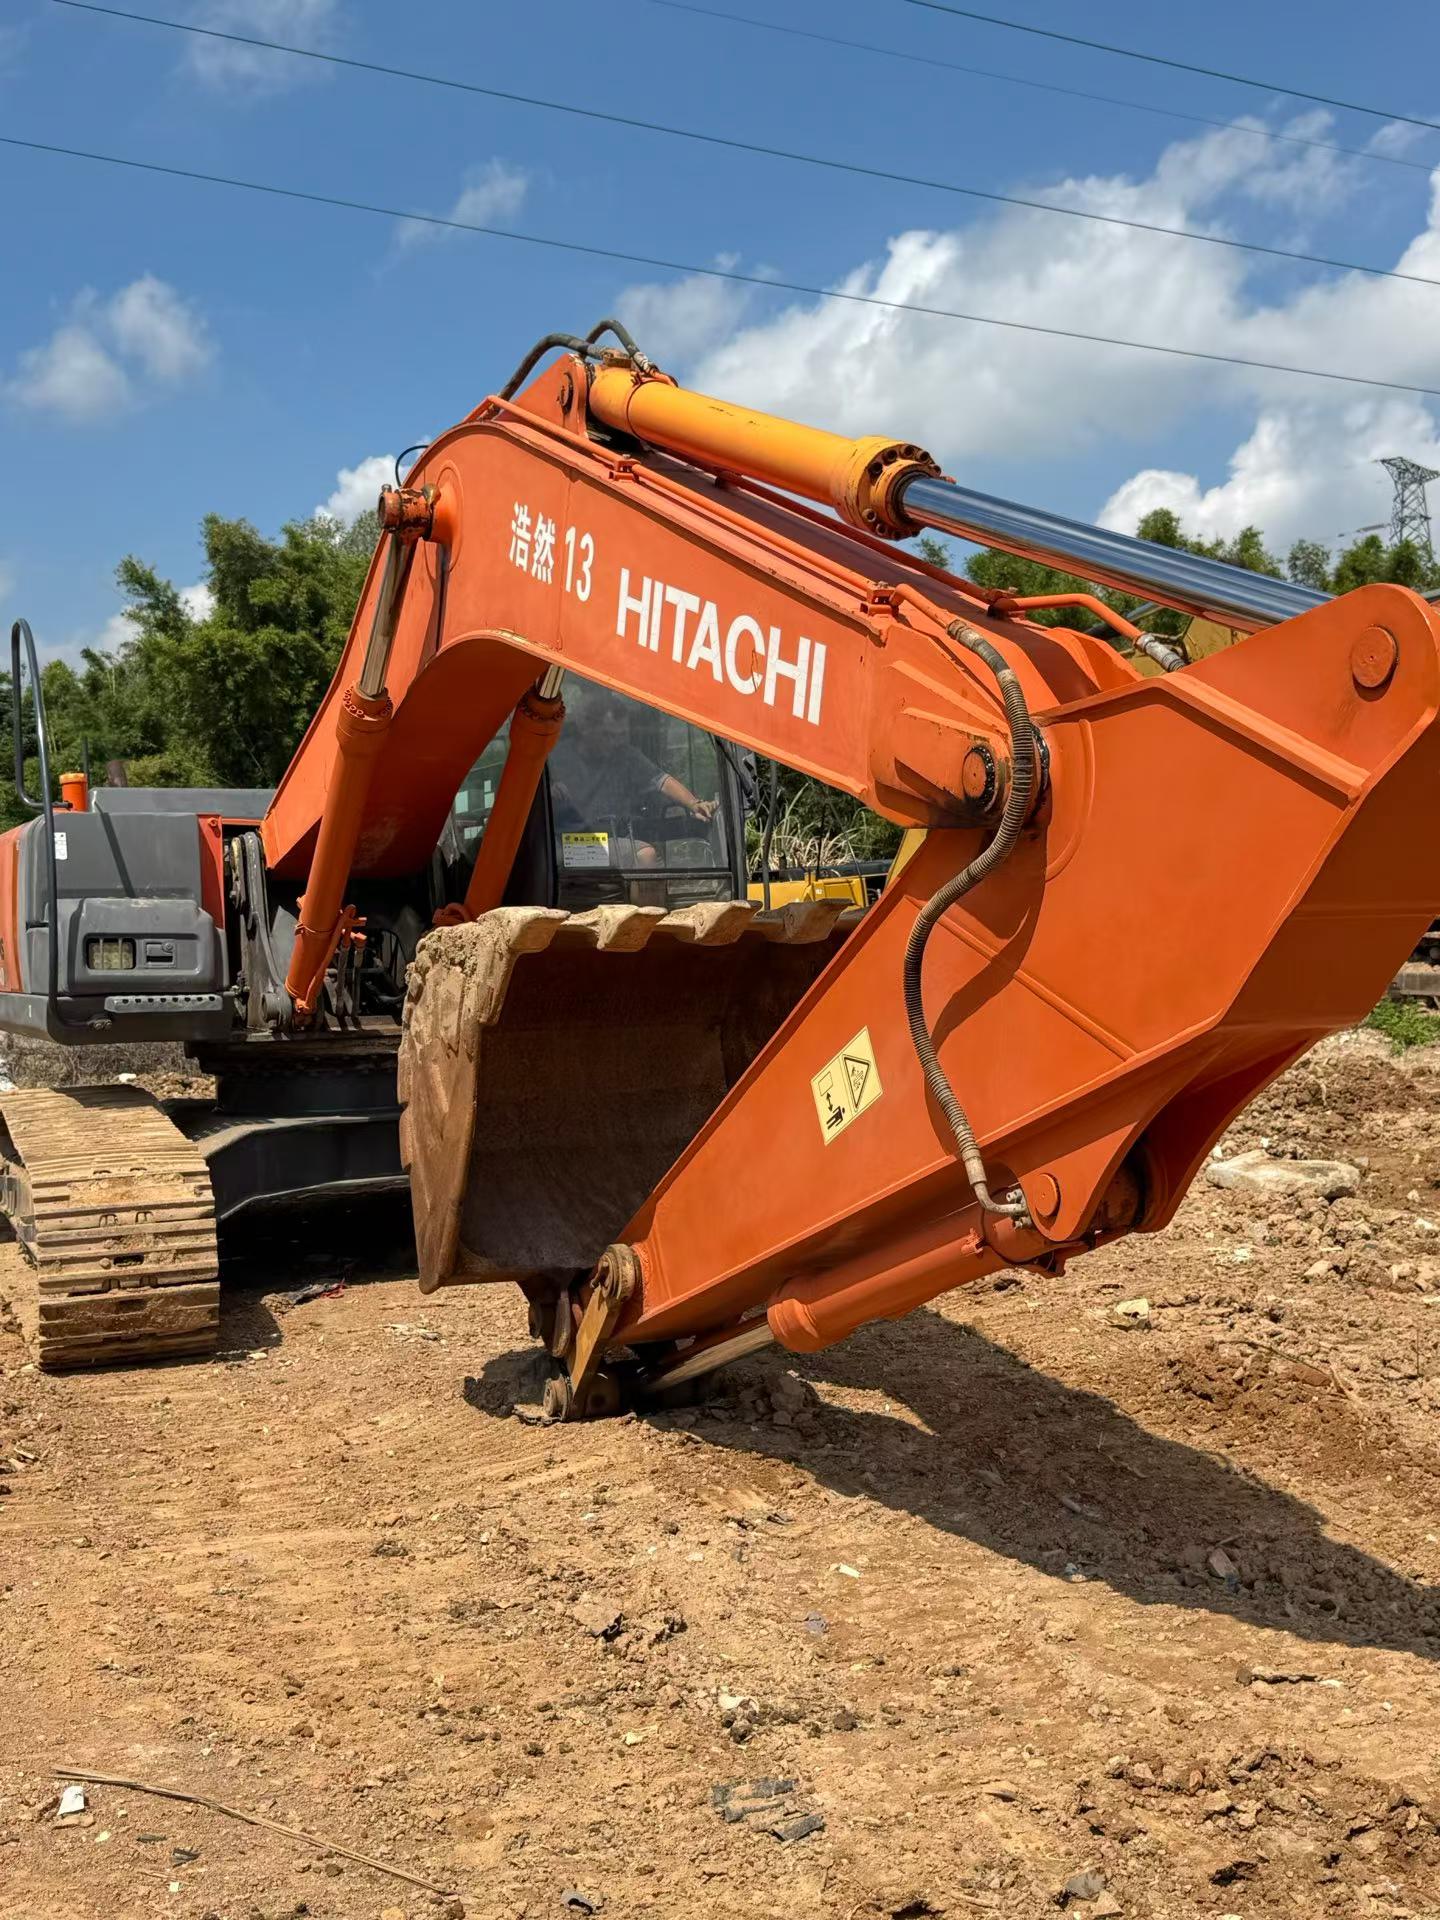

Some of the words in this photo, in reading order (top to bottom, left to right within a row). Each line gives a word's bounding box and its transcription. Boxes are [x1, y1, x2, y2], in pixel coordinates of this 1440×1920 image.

[509, 501, 556, 584] 浩然
[565, 526, 595, 602] 13
[616, 567, 827, 726] HITACHI
